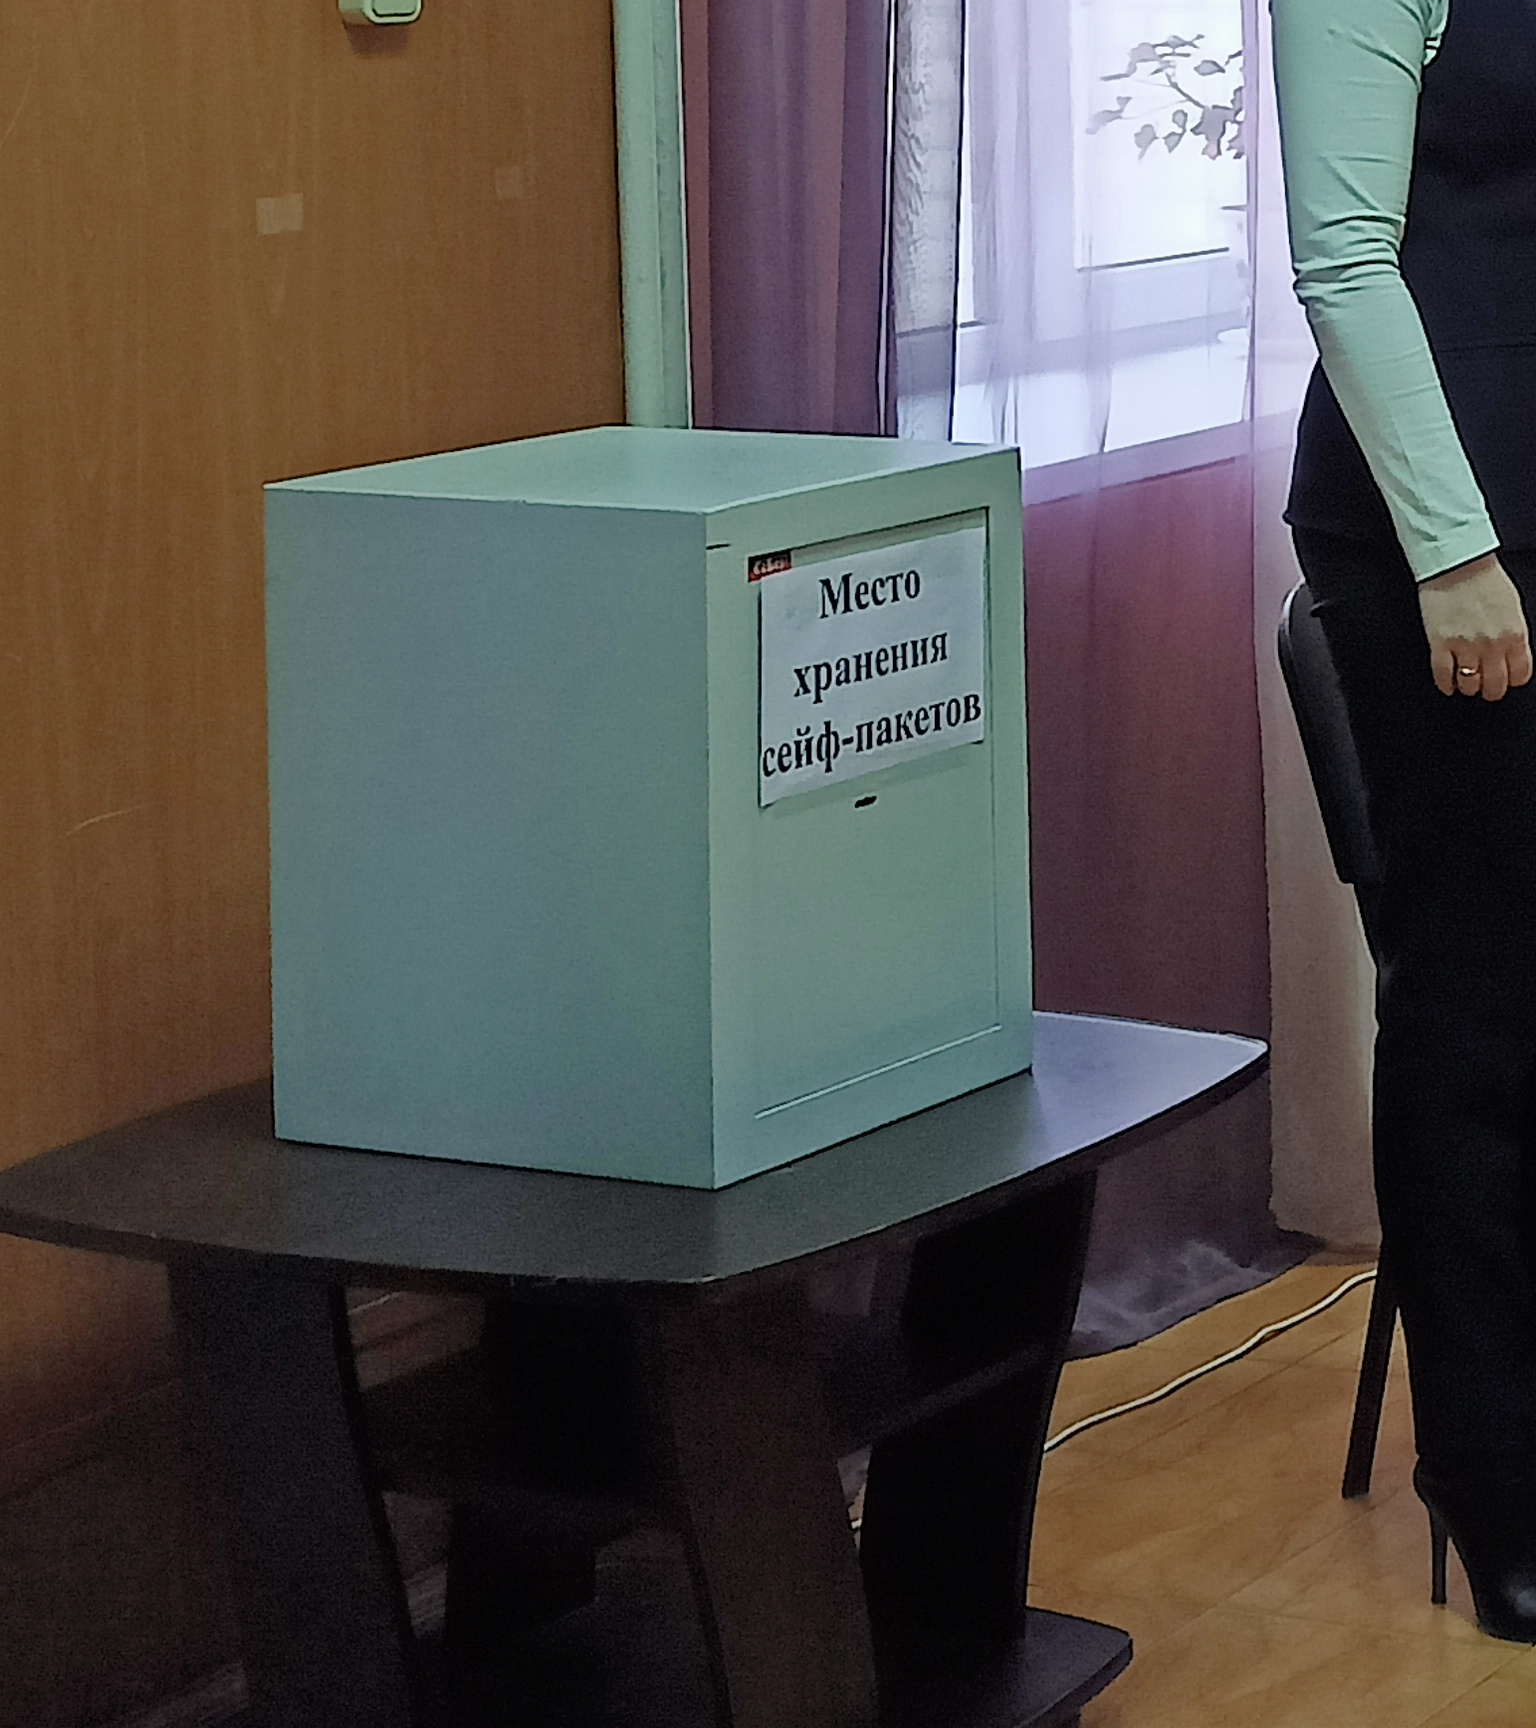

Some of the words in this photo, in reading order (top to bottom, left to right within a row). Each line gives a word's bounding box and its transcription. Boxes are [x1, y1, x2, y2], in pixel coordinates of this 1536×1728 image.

[818, 569, 921, 619] Место
[793, 632, 948, 704] хранения
[762, 693, 982, 777] сейф-пакетов
